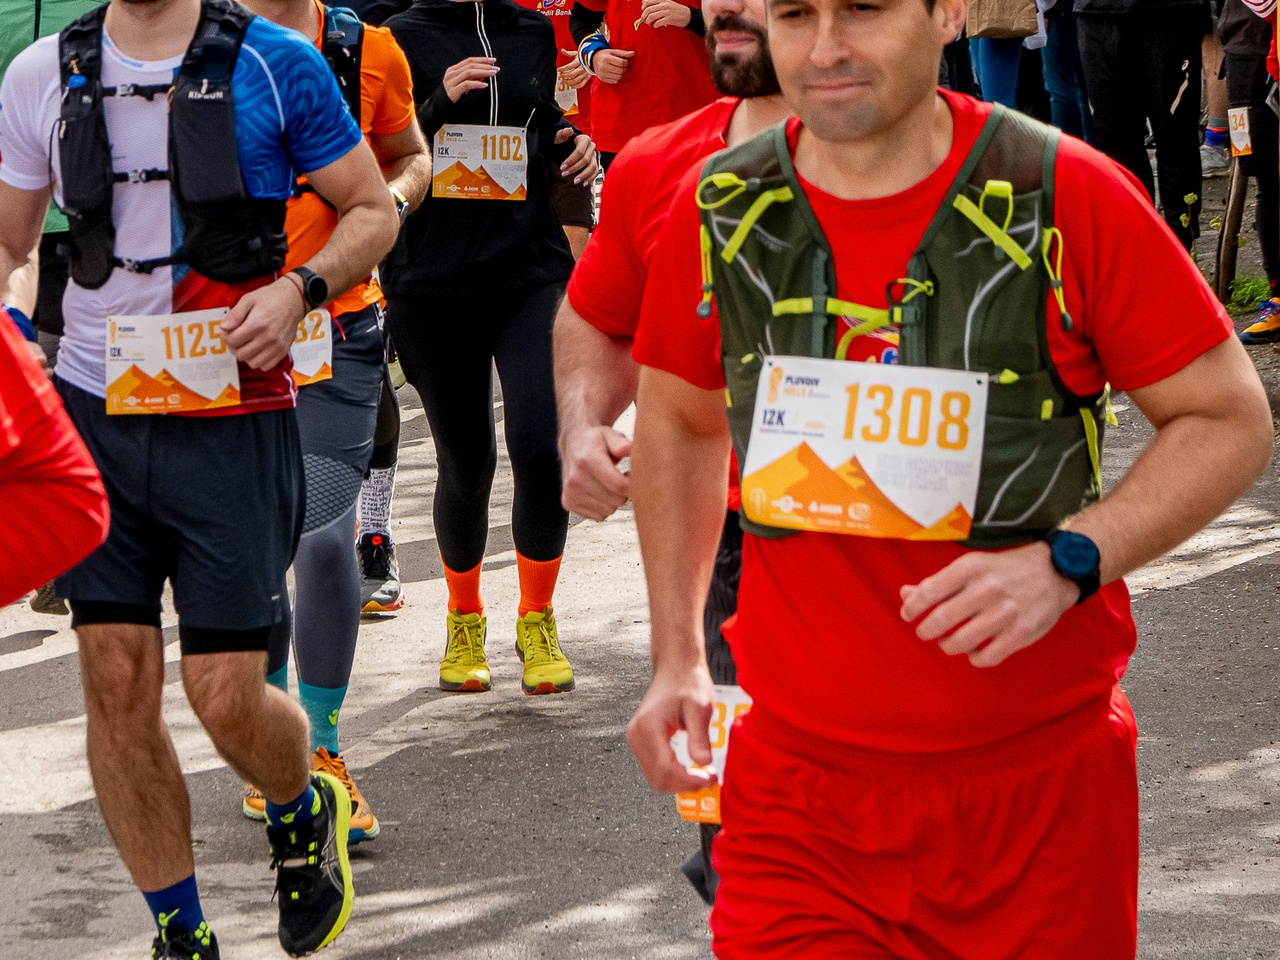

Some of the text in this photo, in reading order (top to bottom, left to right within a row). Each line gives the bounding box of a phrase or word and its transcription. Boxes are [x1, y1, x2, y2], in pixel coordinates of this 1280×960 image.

[437, 146, 449, 155] 12K
[481, 134, 523, 162] 1102
[762, 408, 786, 427] 12K
[843, 382, 971, 451] 1308
